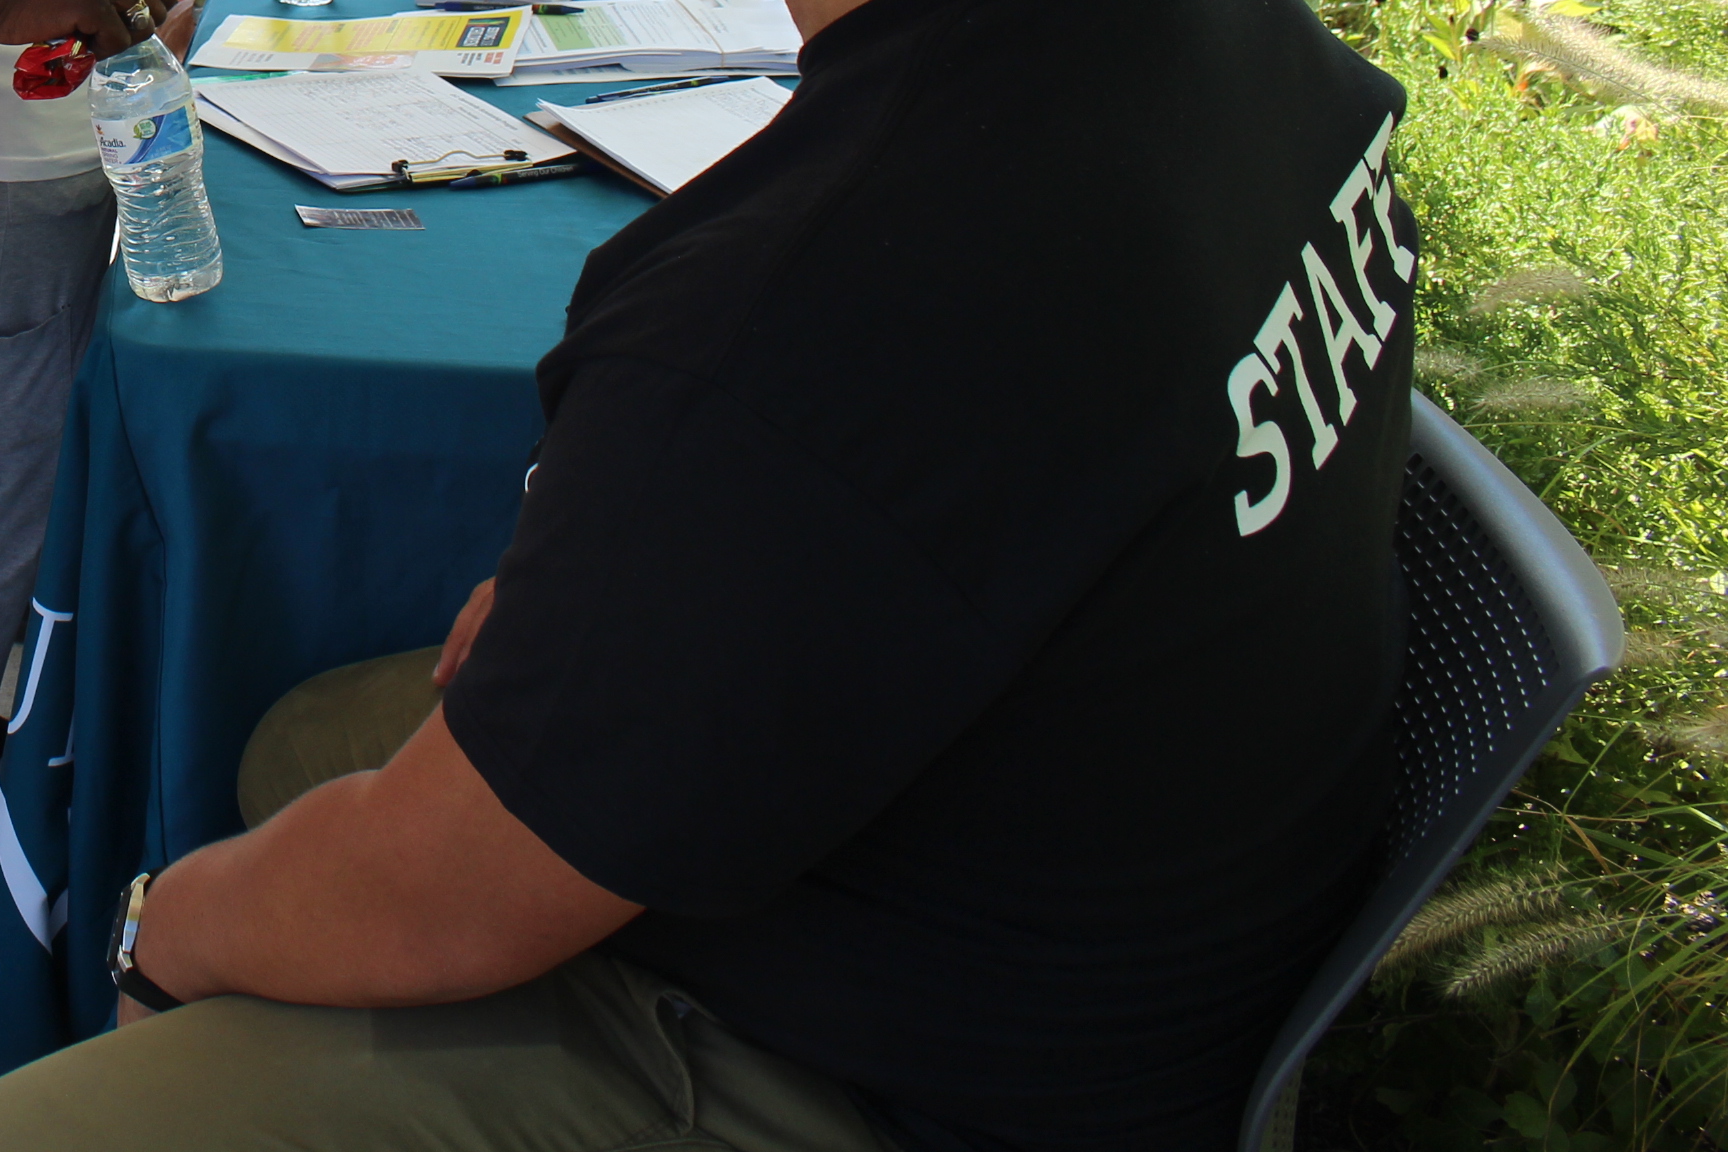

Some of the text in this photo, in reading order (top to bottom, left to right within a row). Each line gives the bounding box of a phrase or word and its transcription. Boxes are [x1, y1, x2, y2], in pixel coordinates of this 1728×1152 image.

[100, 137, 124, 148] Acadia
[518, 169, 539, 178] Serving
[539, 168, 551, 176] Our
[1227, 111, 1416, 537] STAFF
